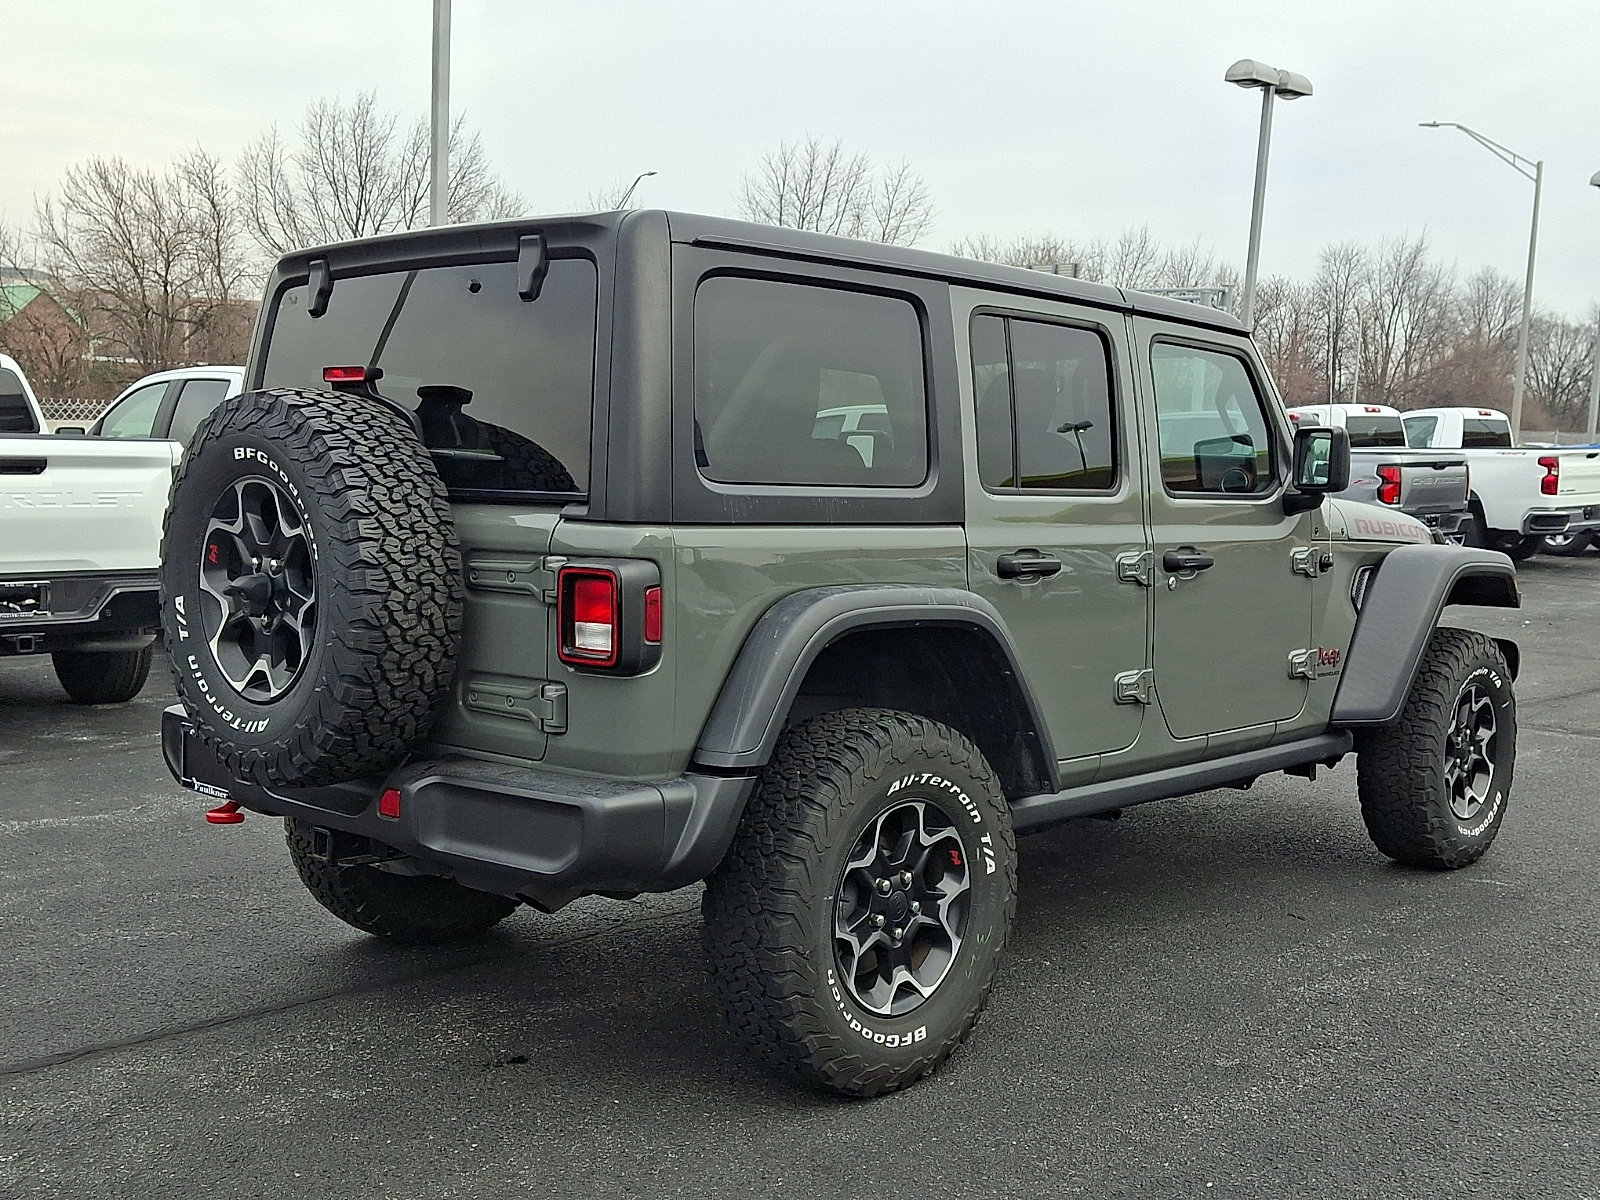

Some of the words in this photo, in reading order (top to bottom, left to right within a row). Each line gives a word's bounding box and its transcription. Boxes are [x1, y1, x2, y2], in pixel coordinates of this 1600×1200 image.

[0, 492, 144, 508] ROLET
[233, 447, 318, 561] BFGoodrich
[174, 595, 189, 642] T/A
[1317, 646, 1341, 668] Jeep
[1489, 670, 1502, 689] T/A
[187, 654, 270, 733] All-Terrain
[194, 782, 229, 799] Faulkner
[1457, 790, 1502, 838] BFGoodrich
[886, 773, 982, 824] All-Terrain
[980, 831, 996, 875] T/A
[827, 969, 928, 1048] BFGoodrich
